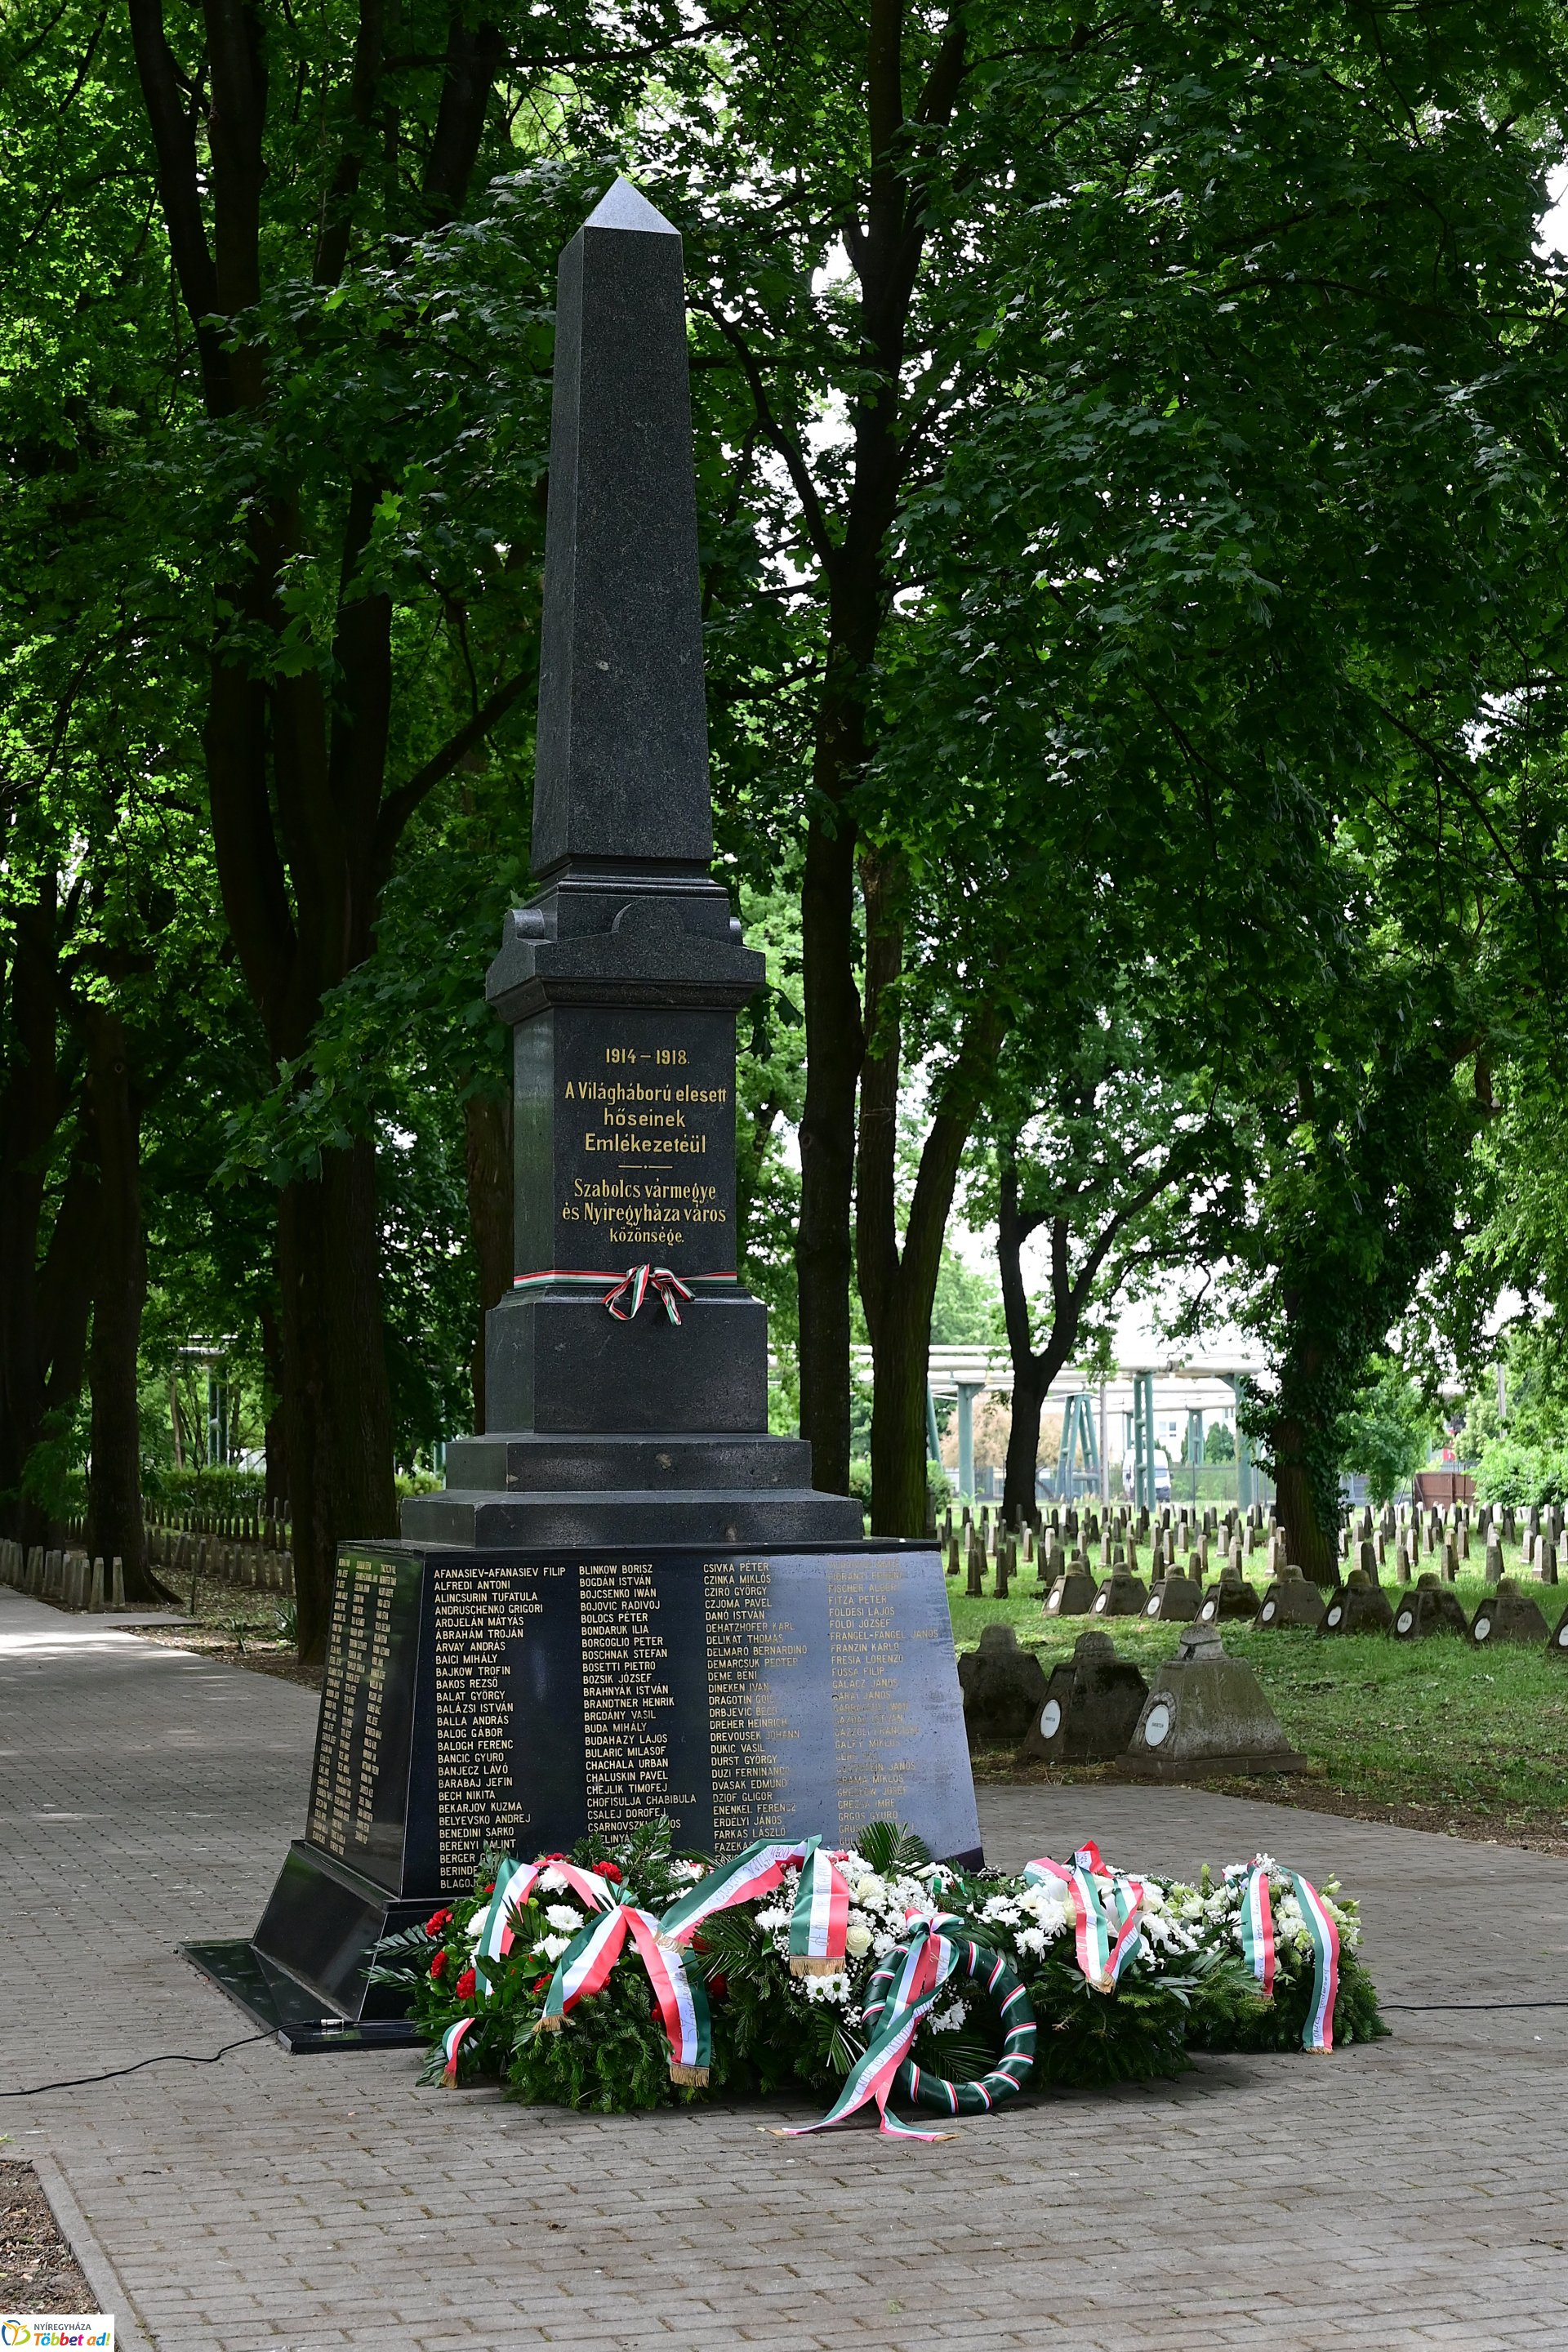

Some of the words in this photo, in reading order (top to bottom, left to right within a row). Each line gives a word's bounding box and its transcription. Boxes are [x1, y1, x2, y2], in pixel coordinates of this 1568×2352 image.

[606, 1048, 636, 1064] 1914
[565, 1081, 575, 1099] A
[578, 1081, 671, 1105] Világháború
[675, 1085, 727, 1102] elesett
[604, 1107, 686, 1127] hőseinek
[585, 1133, 706, 1153] Emlékezetéül
[574, 1178, 641, 1198] Szabolcs
[644, 1178, 716, 1204] vármegye
[562, 1201, 580, 1220] és
[684, 1204, 726, 1223] város
[434, 1566, 539, 1579] AFANASIEV-AFANASIEV
[543, 1566, 566, 1576] FILIP
[578, 1565, 617, 1575] BLINKOW
[621, 1564, 653, 1574] BORISZ
[702, 1563, 734, 1573] CSIVKA
[739, 1560, 768, 1572] PÉTER
[579, 1575, 615, 1588] BOGDÁN
[618, 1574, 652, 1586] ISTVÁN
[702, 1575, 734, 1585] CZINKA
[739, 1572, 771, 1585] MIKLÓS
[434, 1580, 473, 1591] ALFREDI
[477, 1579, 510, 1590] ANTONI
[703, 1584, 730, 1597] CZIRÓ
[733, 1584, 767, 1597] GYÖRGY
[434, 1592, 488, 1603] ALINCSURIN
[492, 1592, 537, 1602] TUFATULA
[580, 1588, 630, 1600] BOJCSENKO
[434, 1605, 505, 1615] ANDRUSCHENKO
[508, 1603, 543, 1614] GRIGORI
[580, 1601, 617, 1611] BOJOVIC
[621, 1600, 661, 1610] RADIVOJ
[744, 1598, 771, 1608] PAVEL
[581, 1613, 614, 1624] BOLOCS
[618, 1610, 648, 1623] PÉTER
[705, 1609, 729, 1621] DANÓ
[733, 1607, 765, 1620] ISTVÁN
[435, 1615, 484, 1628] ARDJELÁN
[488, 1614, 524, 1626] MÁTYÁS
[434, 1627, 483, 1640] ÁBRAHÁM
[488, 1626, 524, 1638] TROJÁN
[581, 1625, 628, 1636] BONDARUK
[631, 1624, 649, 1634] ILIA
[435, 1640, 465, 1652] ÁRVAY
[470, 1639, 506, 1651] ANDRÁS
[581, 1637, 630, 1648] BORGOGLIO
[634, 1636, 663, 1646] PETER
[706, 1635, 742, 1645] DELIKAT
[435, 1655, 459, 1664] BAICI
[462, 1651, 497, 1664] MIHÁLY
[582, 1650, 629, 1660] BOSCHNAK
[634, 1648, 668, 1659] STEFAN
[581, 1662, 620, 1673] BOSETTI
[624, 1661, 656, 1671] PIETRO
[706, 1659, 760, 1669] DEMARCSUK
[435, 1667, 473, 1677] BAJKOW
[478, 1666, 511, 1676] TROFIN
[582, 1674, 613, 1685] BOZSIK
[617, 1670, 651, 1683] JÓZSEF
[707, 1672, 733, 1682] DEME
[737, 1668, 757, 1680] BÉNI
[436, 1679, 466, 1689] BAKOS
[583, 1683, 632, 1696] BRAHNYÁK
[635, 1682, 669, 1695] ISTVÁN
[708, 1683, 746, 1694] DINEKEN
[436, 1691, 466, 1702] BALAT
[470, 1688, 505, 1700] GYÖRGY
[708, 1695, 753, 1705] DRAGOTIN
[436, 1701, 476, 1714] BALÁZSI
[480, 1700, 514, 1713] ISTVÁN
[583, 1698, 638, 1708] BRANDTNER
[642, 1696, 675, 1707] HENRIK
[437, 1717, 468, 1726] BALLA
[473, 1713, 510, 1726] ANDRÁS
[630, 1709, 656, 1720] VASIL
[584, 1723, 608, 1733] BUDA
[612, 1720, 647, 1732] MIHÁLY
[709, 1719, 744, 1730] DREHER
[437, 1729, 466, 1739] BALOG
[470, 1725, 503, 1738] GÁBOR
[710, 1731, 761, 1742] DREVOUSEK
[437, 1741, 474, 1751] BALOGH
[478, 1740, 514, 1750] FERENC
[585, 1735, 635, 1746] BUDAHAZY
[639, 1734, 668, 1744] LAJOS
[585, 1748, 623, 1758] BULARIC
[626, 1746, 666, 1757] MILASOF
[710, 1744, 736, 1754] DUKIC
[741, 1744, 763, 1753] VASIL
[437, 1753, 470, 1763] BANCIC
[474, 1752, 504, 1762] GYURO
[710, 1756, 738, 1766] DURST
[586, 1760, 635, 1771] CHACHALA
[639, 1758, 669, 1768] URBAN
[438, 1766, 479, 1776] BANJECZ
[586, 1772, 636, 1783] CHALUSKIN
[640, 1770, 669, 1780] PAVEL
[710, 1769, 732, 1779] DUZI
[438, 1778, 482, 1788] BARABAJ
[486, 1777, 513, 1787] JEFIN
[711, 1780, 746, 1791] DVASAK
[586, 1784, 623, 1795] CHEJLIK
[628, 1783, 667, 1793] TIMOFEJ
[438, 1791, 461, 1801] BECH
[466, 1790, 495, 1800] NIKITA
[586, 1797, 641, 1807] CHOFISULJA
[645, 1794, 696, 1805] CHABIBULA
[742, 1792, 773, 1802] GLIGOR
[439, 1803, 486, 1813] BEKARJOV
[490, 1802, 522, 1811] KUZMA
[587, 1809, 621, 1820] CSALEJ
[626, 1807, 669, 1818] DOROFEJ
[712, 1805, 752, 1815] ENENKEL
[439, 1815, 491, 1826] BELYEVSKO
[495, 1814, 531, 1824] ANDREJ
[713, 1815, 750, 1828] ERDÉLYI
[753, 1814, 782, 1826] JÁNOS
[439, 1828, 481, 1838] BENEDINI
[485, 1827, 514, 1837] SARKO
[713, 1829, 748, 1839] FARKAS
[439, 1838, 479, 1851] BERÉNYI
[483, 1837, 516, 1849] ÁLINT
[439, 1853, 475, 1864] BERGER
